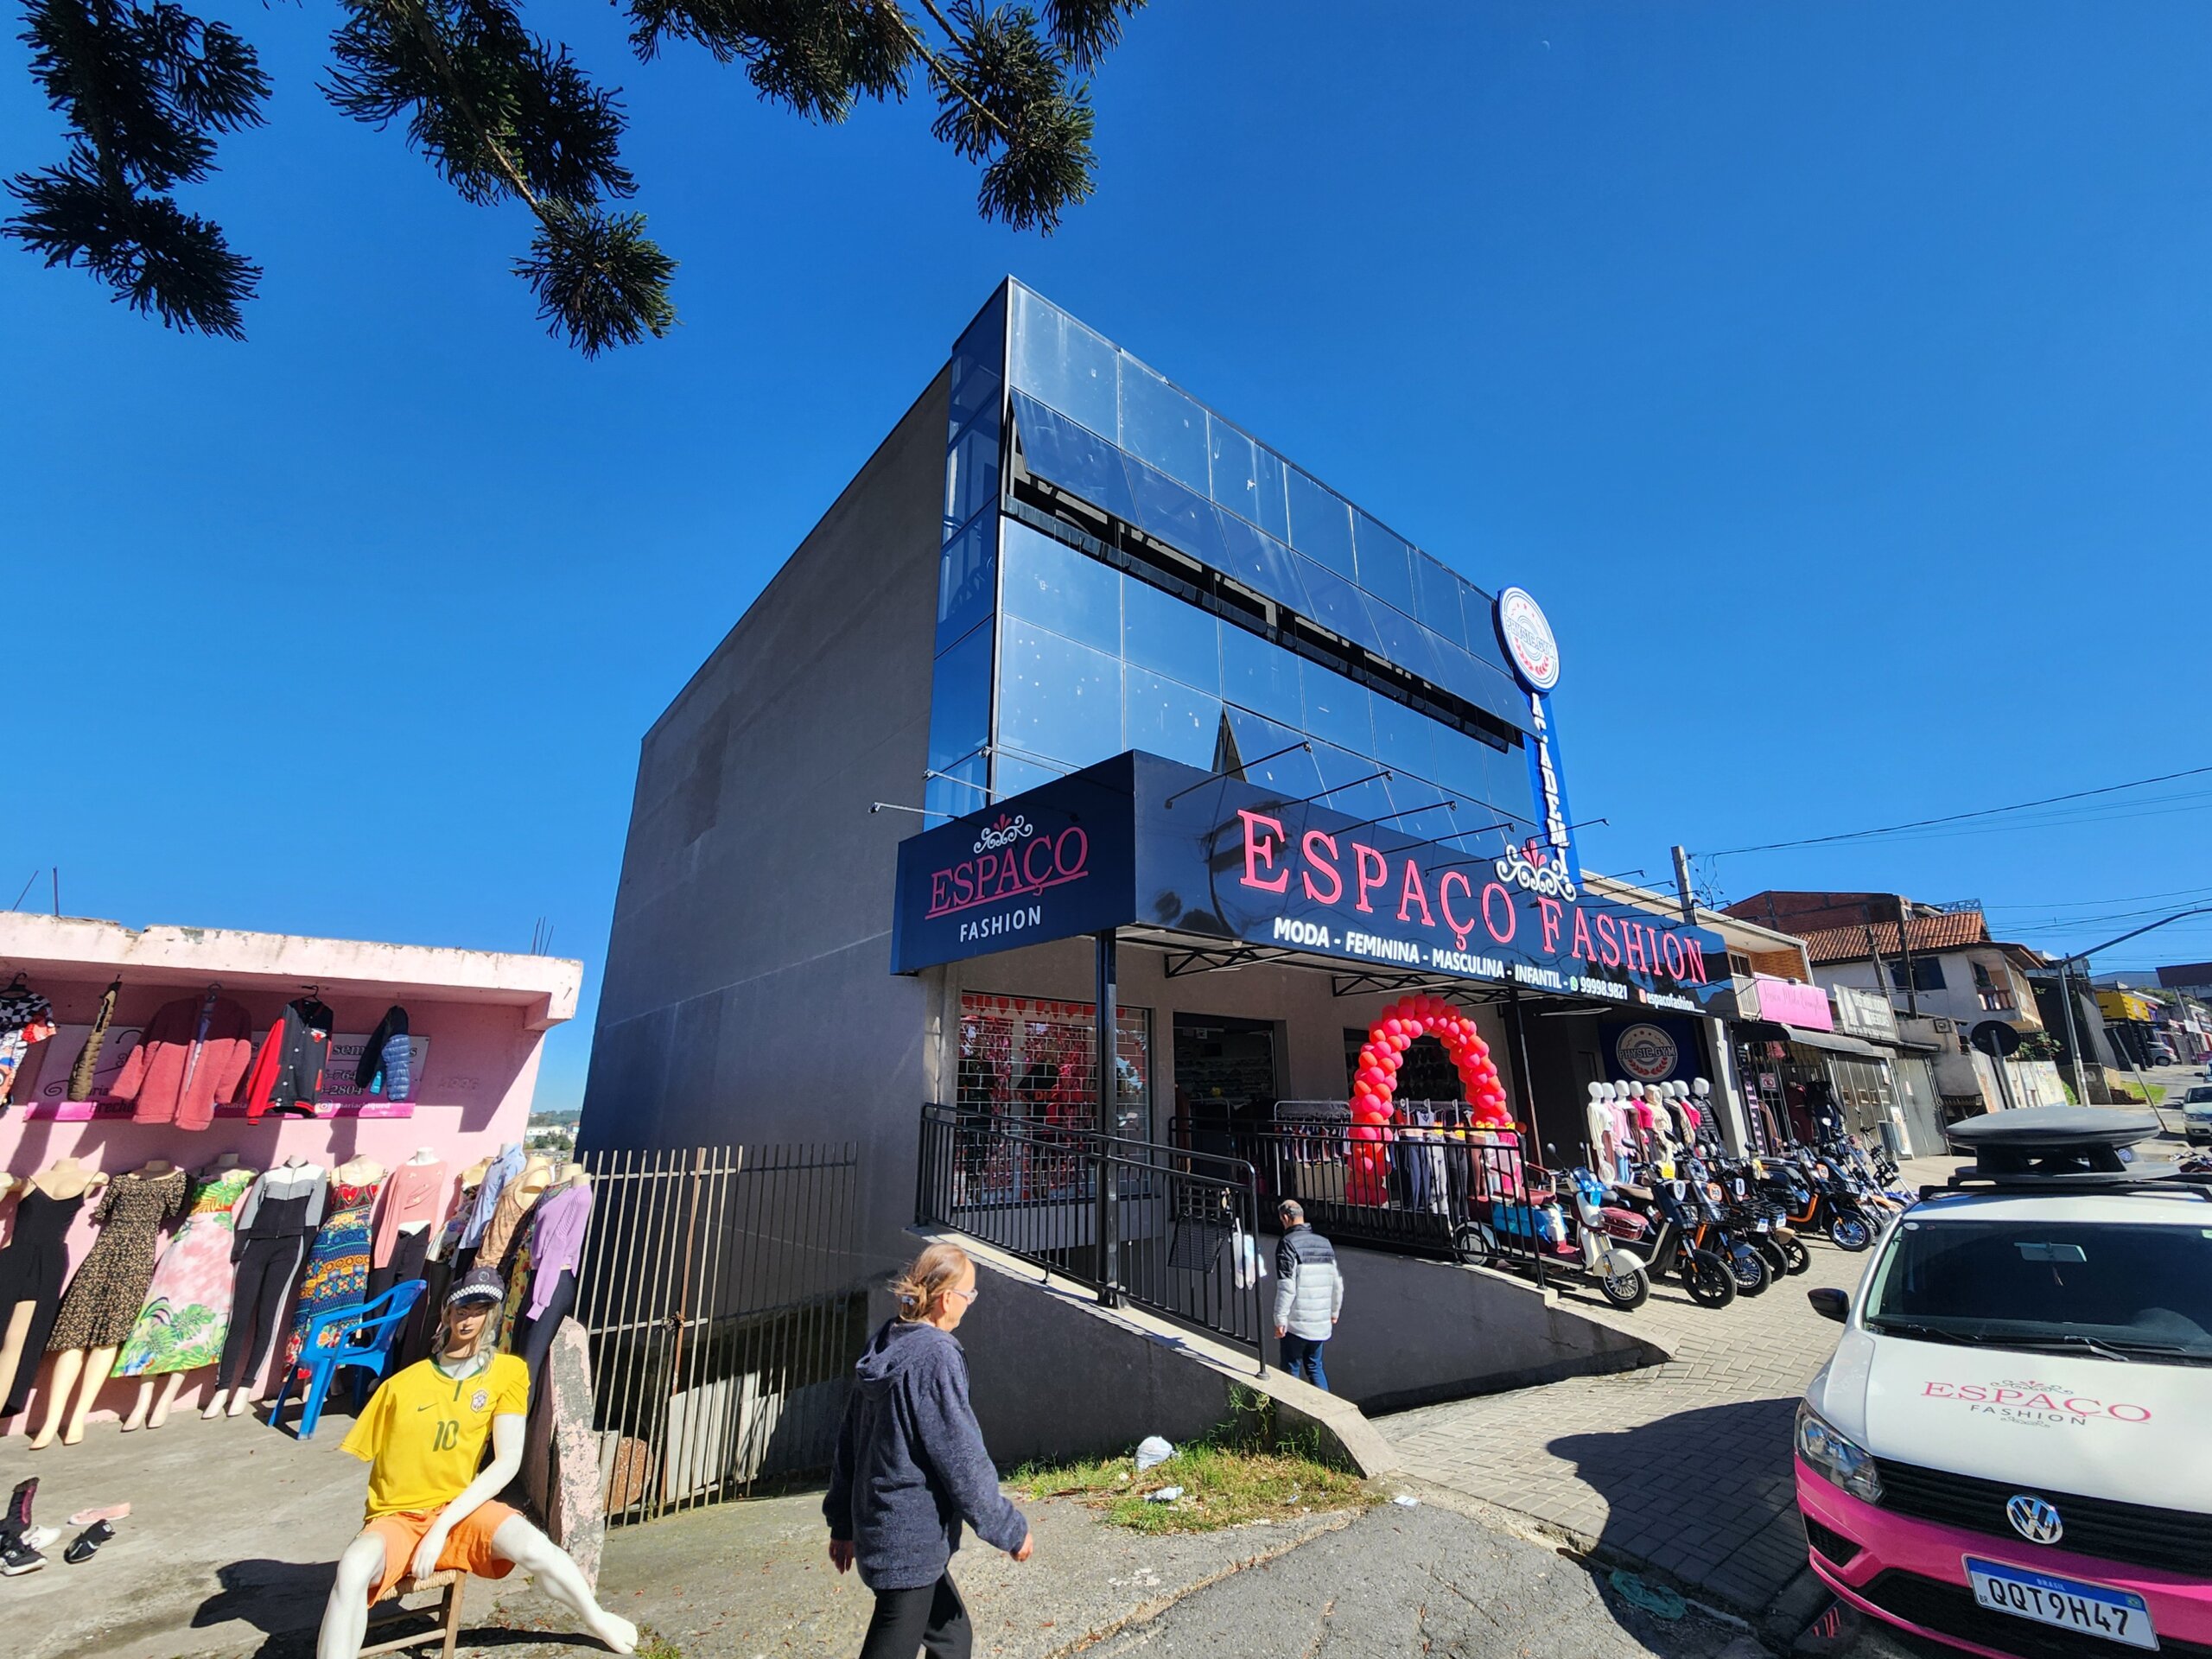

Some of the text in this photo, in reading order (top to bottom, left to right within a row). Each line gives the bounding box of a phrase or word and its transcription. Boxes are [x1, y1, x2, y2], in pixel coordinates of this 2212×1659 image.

[1531, 692, 1571, 883] ACADEMI
[925, 826, 1090, 919] ESPAÇO
[1236, 808, 1710, 986] ESPAÇO FASHION
[960, 905, 1041, 943] FASHION
[1273, 916, 1331, 949] MODA
[1345, 931, 1421, 964] FEMININA
[1432, 948, 1506, 980] MASCULINA
[1514, 963, 1562, 990] INFANTIL
[1580, 976, 1628, 1001] 99998.9821
[1922, 1381, 2153, 1425] ESPAÇO
[1971, 1404, 2088, 1426] FASHION
[433, 1419, 460, 1452] 10
[1988, 1578, 2128, 1637] QQT9H47
[2037, 1578, 2066, 1592] BRASIL
